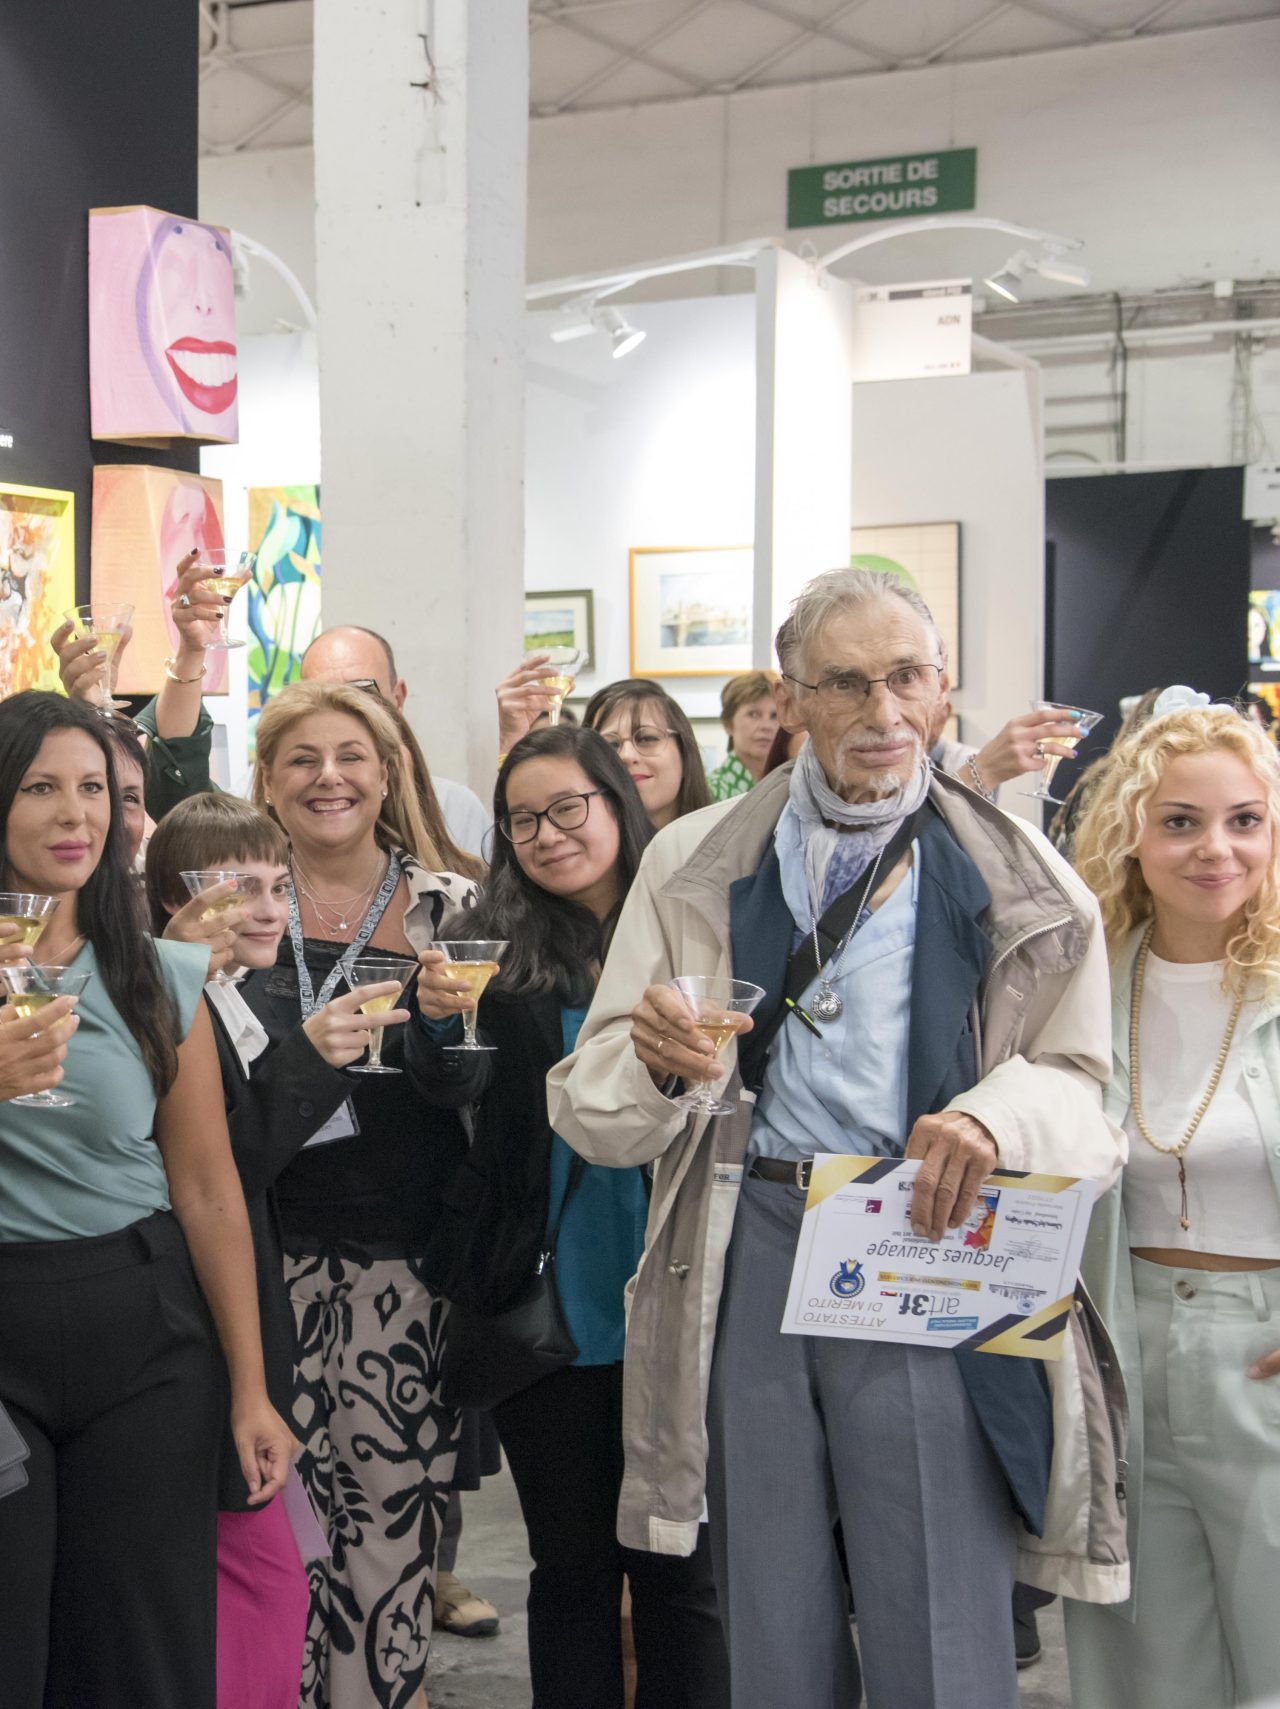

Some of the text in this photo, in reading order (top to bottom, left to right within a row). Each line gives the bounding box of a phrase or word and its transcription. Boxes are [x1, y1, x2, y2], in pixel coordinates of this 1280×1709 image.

[823, 158, 939, 191] SORTIE DE
[823, 186, 938, 217] SECOURS
[866, 1239, 939, 1265] Sauvage
[942, 1248, 1015, 1272] Jacques
[808, 1297, 883, 1312] DI MERITO
[803, 1312, 887, 1328] ATTESTATO
